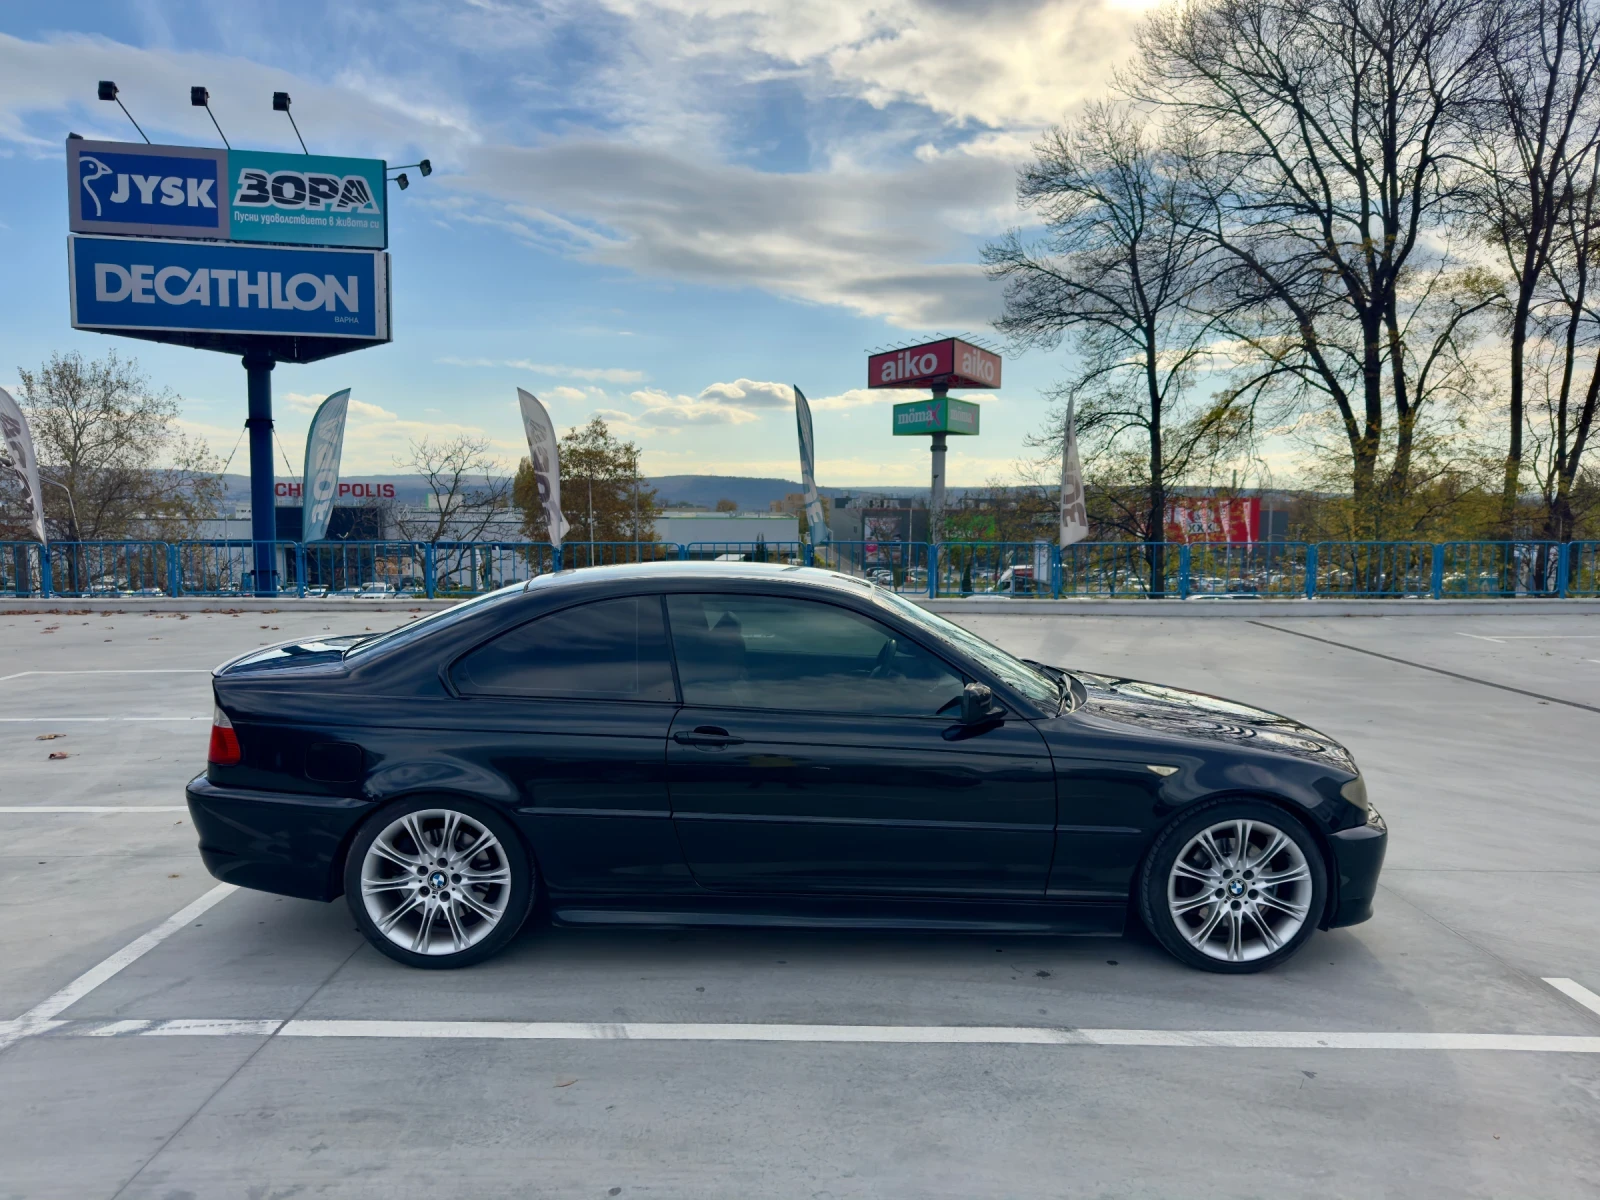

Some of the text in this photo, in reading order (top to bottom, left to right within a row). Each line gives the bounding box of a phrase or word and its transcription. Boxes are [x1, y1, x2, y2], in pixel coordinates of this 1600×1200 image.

[109, 173, 217, 208] JYSK
[232, 168, 380, 214] ЗОРА
[234, 211, 259, 224] Пусни
[260, 213, 327, 226] удоволствието
[335, 216, 368, 228] живота
[369, 220, 379, 229] си
[94, 262, 359, 313] DECATHLON
[334, 316, 359, 324] ВАРНА
[881, 351, 938, 382] aiko
[962, 349, 994, 381] aiko
